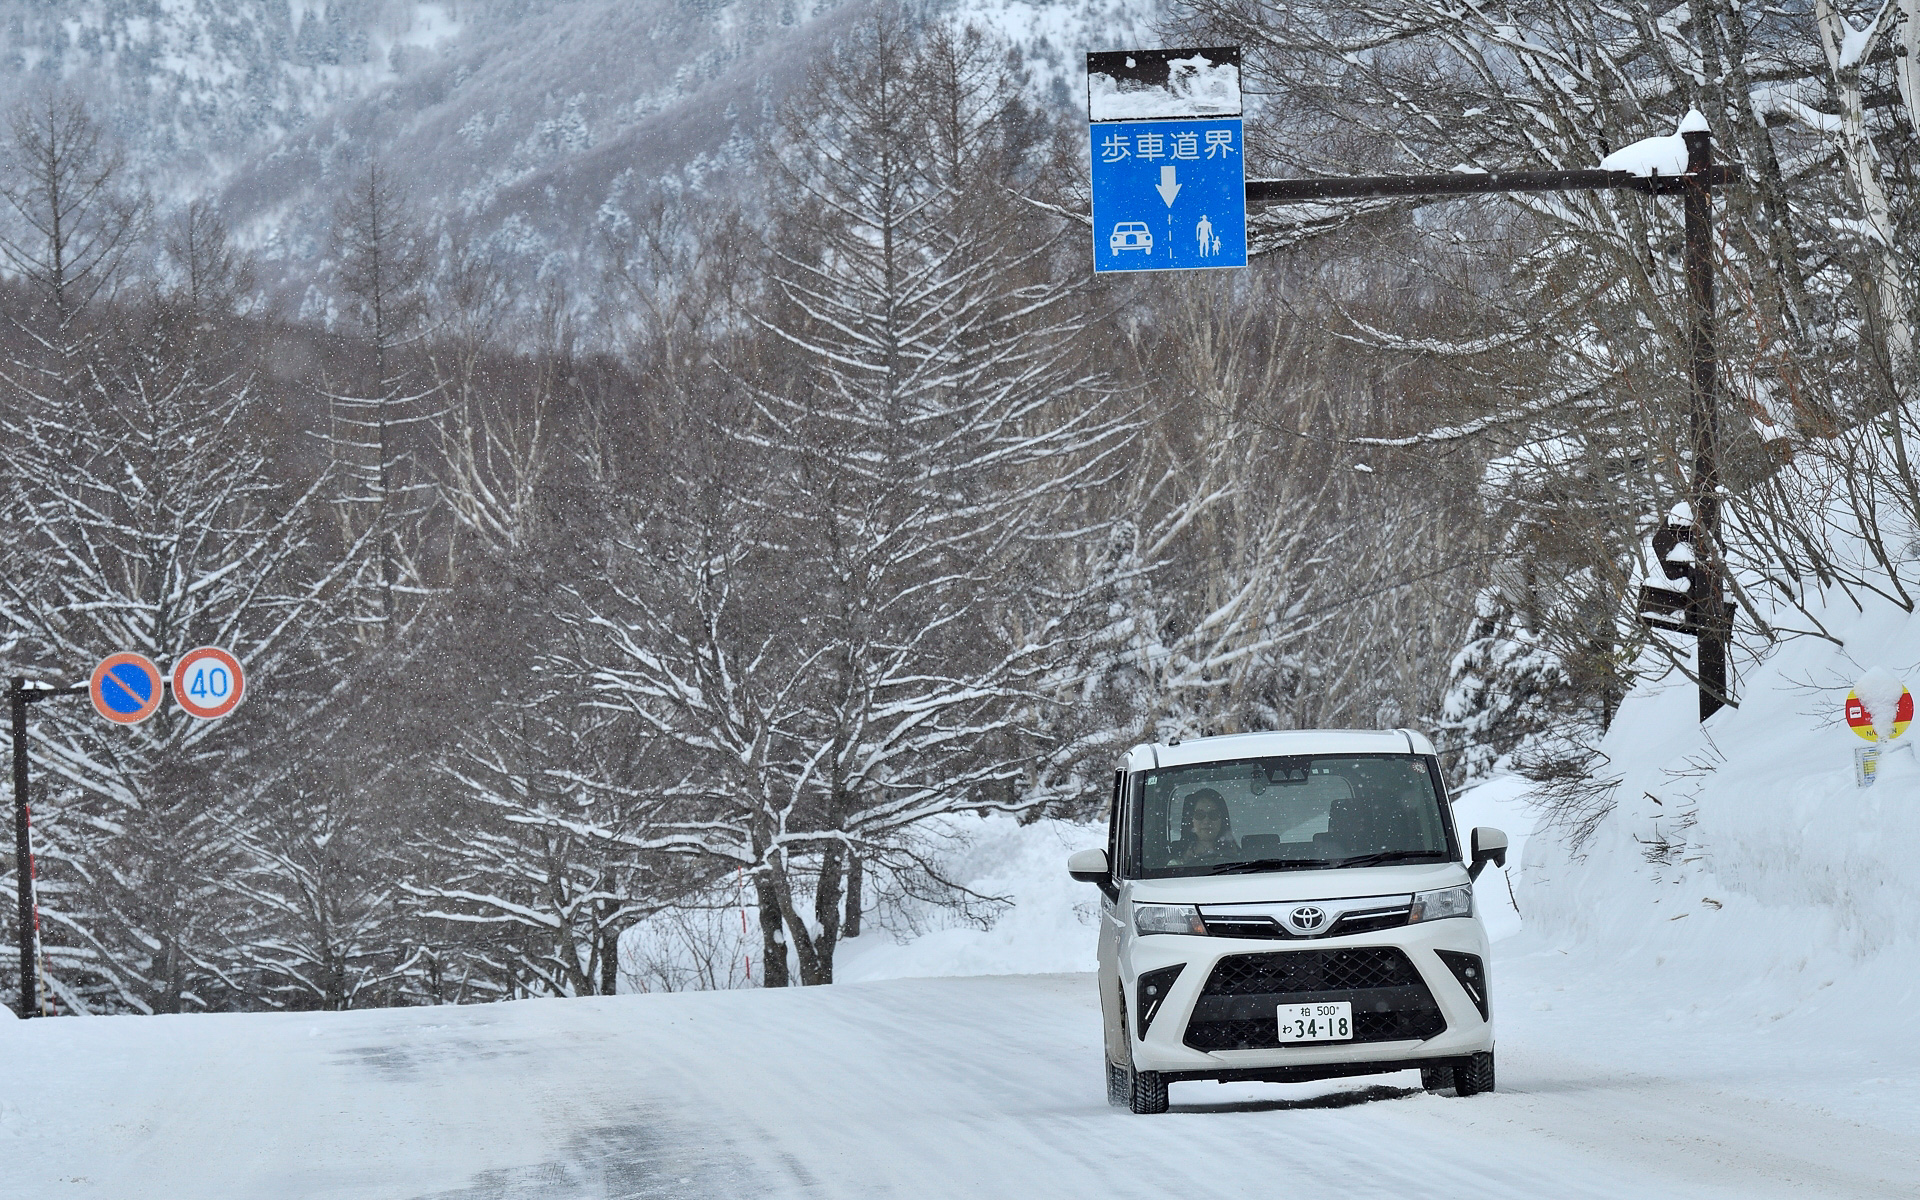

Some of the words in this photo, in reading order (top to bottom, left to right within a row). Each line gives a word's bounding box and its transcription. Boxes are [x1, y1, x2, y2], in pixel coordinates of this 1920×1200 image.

[1101, 129, 1234, 163] 歩車道界
[190, 667, 227, 698] 40
[1300, 1007, 1311, 1017] 柏
[1316, 1005, 1336, 1016] 500
[1282, 1024, 1293, 1034] わ
[1294, 1017, 1349, 1038] 34-18
